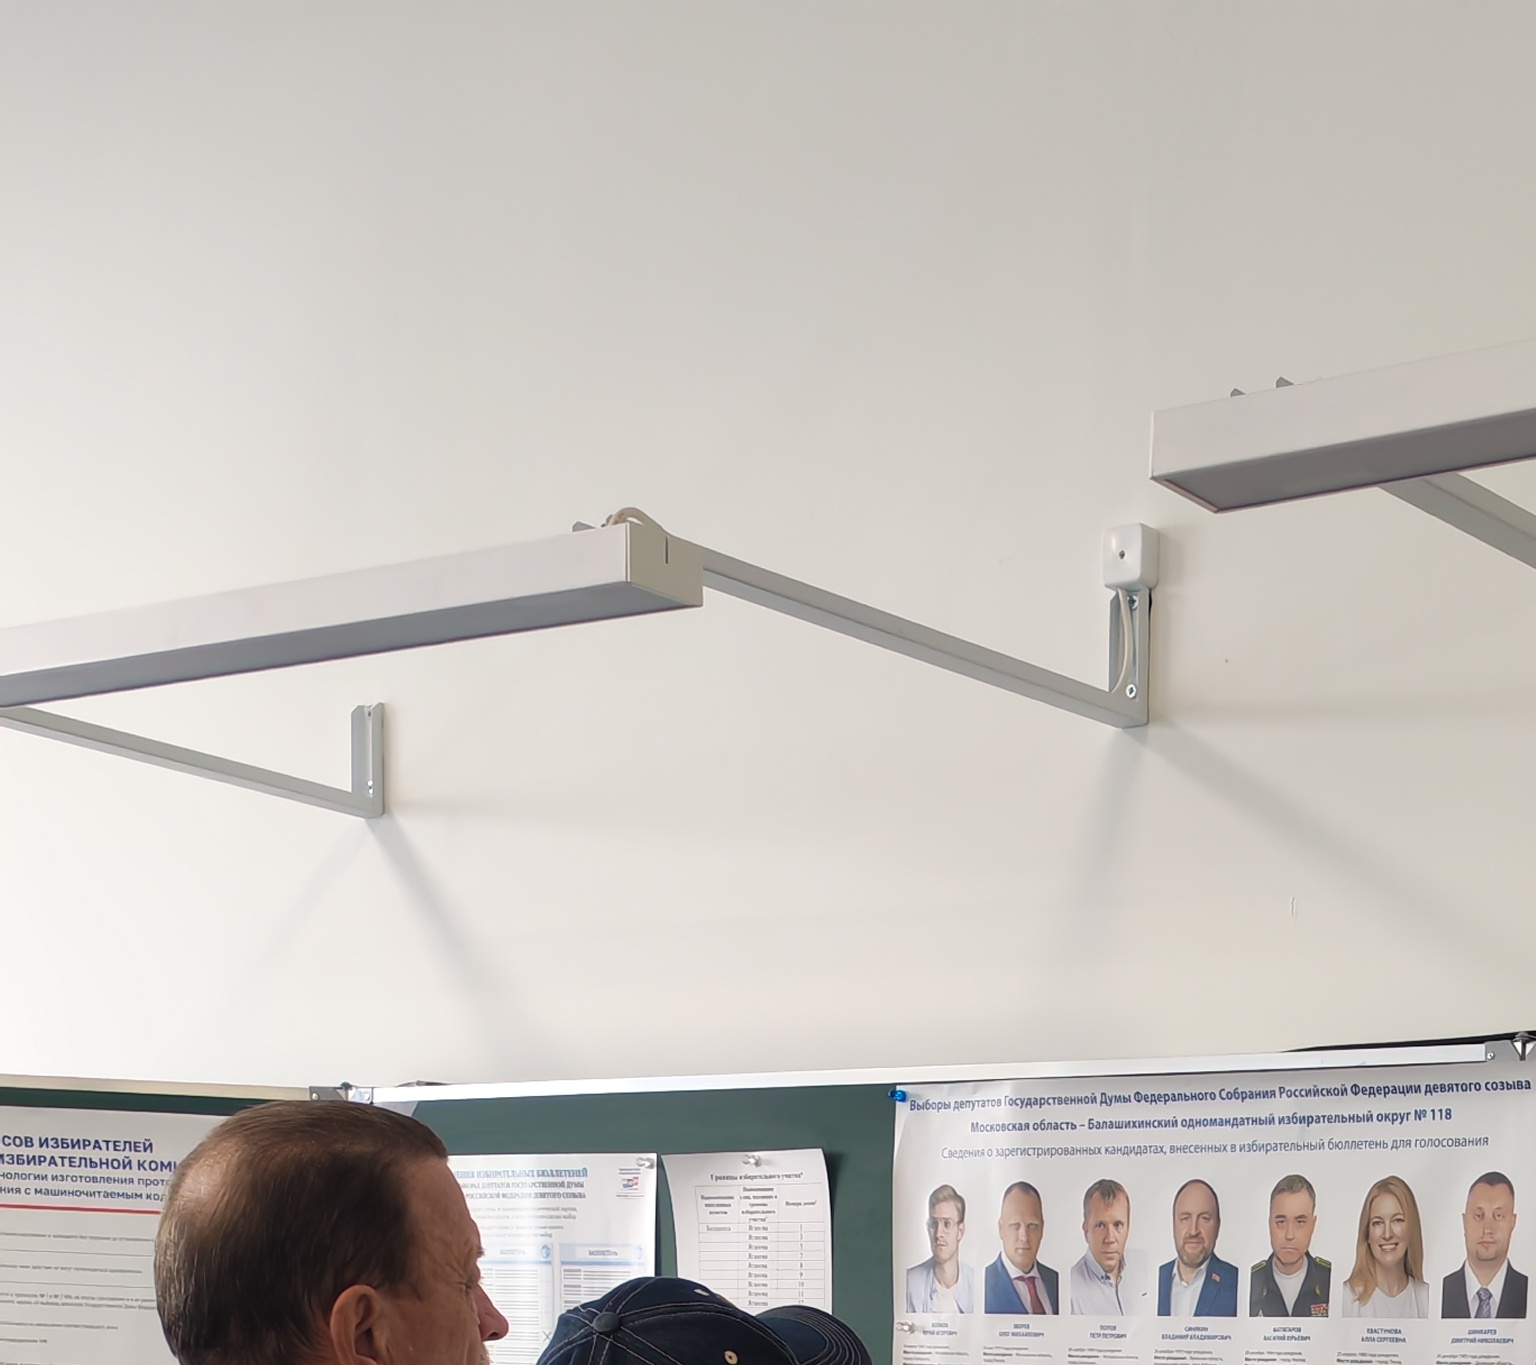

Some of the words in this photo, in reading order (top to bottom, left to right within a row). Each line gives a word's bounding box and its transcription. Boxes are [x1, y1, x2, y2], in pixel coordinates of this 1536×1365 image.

[910, 1099, 950, 1112] Выборы
[952, 1098, 1002, 1111] депутатов
[1004, 1092, 1097, 1108] Государственной
[1099, 1092, 1132, 1106] Думы
[1133, 1091, 1216, 1104] Федерального
[1218, 1087, 1276, 1102] Собрания
[1278, 1083, 1348, 1098] Российской
[1349, 1083, 1422, 1098] Федерации
[1424, 1082, 1482, 1095] девятого
[1484, 1079, 1532, 1091] созыва
[970, 1122, 1030, 1132] Московская
[1032, 1118, 1077, 1131] область
[1087, 1116, 1178, 1129] Балашихинский
[1180, 1113, 1275, 1129] одномандатный
[1277, 1110, 1373, 1126] избирательный
[1376, 1111, 1411, 1125] округ
[1413, 1108, 1427, 1121] №
[1430, 1107, 1452, 1120] 118
[38, 1136, 154, 1154] ИЗБИРАТЕЛЕЙ
[941, 1147, 985, 1159] Сведения
[986, 1148, 993, 1157] о
[994, 1146, 1102, 1158] зарегистрированных
[1104, 1144, 1167, 1156] кандидатах,
[1168, 1143, 1228, 1154] внесенных
[1230, 1143, 1236, 1153] в
[1238, 1138, 1325, 1154] избирательный
[1327, 1137, 1388, 1150] бюллетень
[1390, 1138, 1412, 1151] для
[1414, 1136, 1489, 1151] голосования
[138, 1159, 177, 1172] КОМ
[51, 1174, 134, 1186] изготовления
[34, 1188, 143, 1200] машиночитаемым
